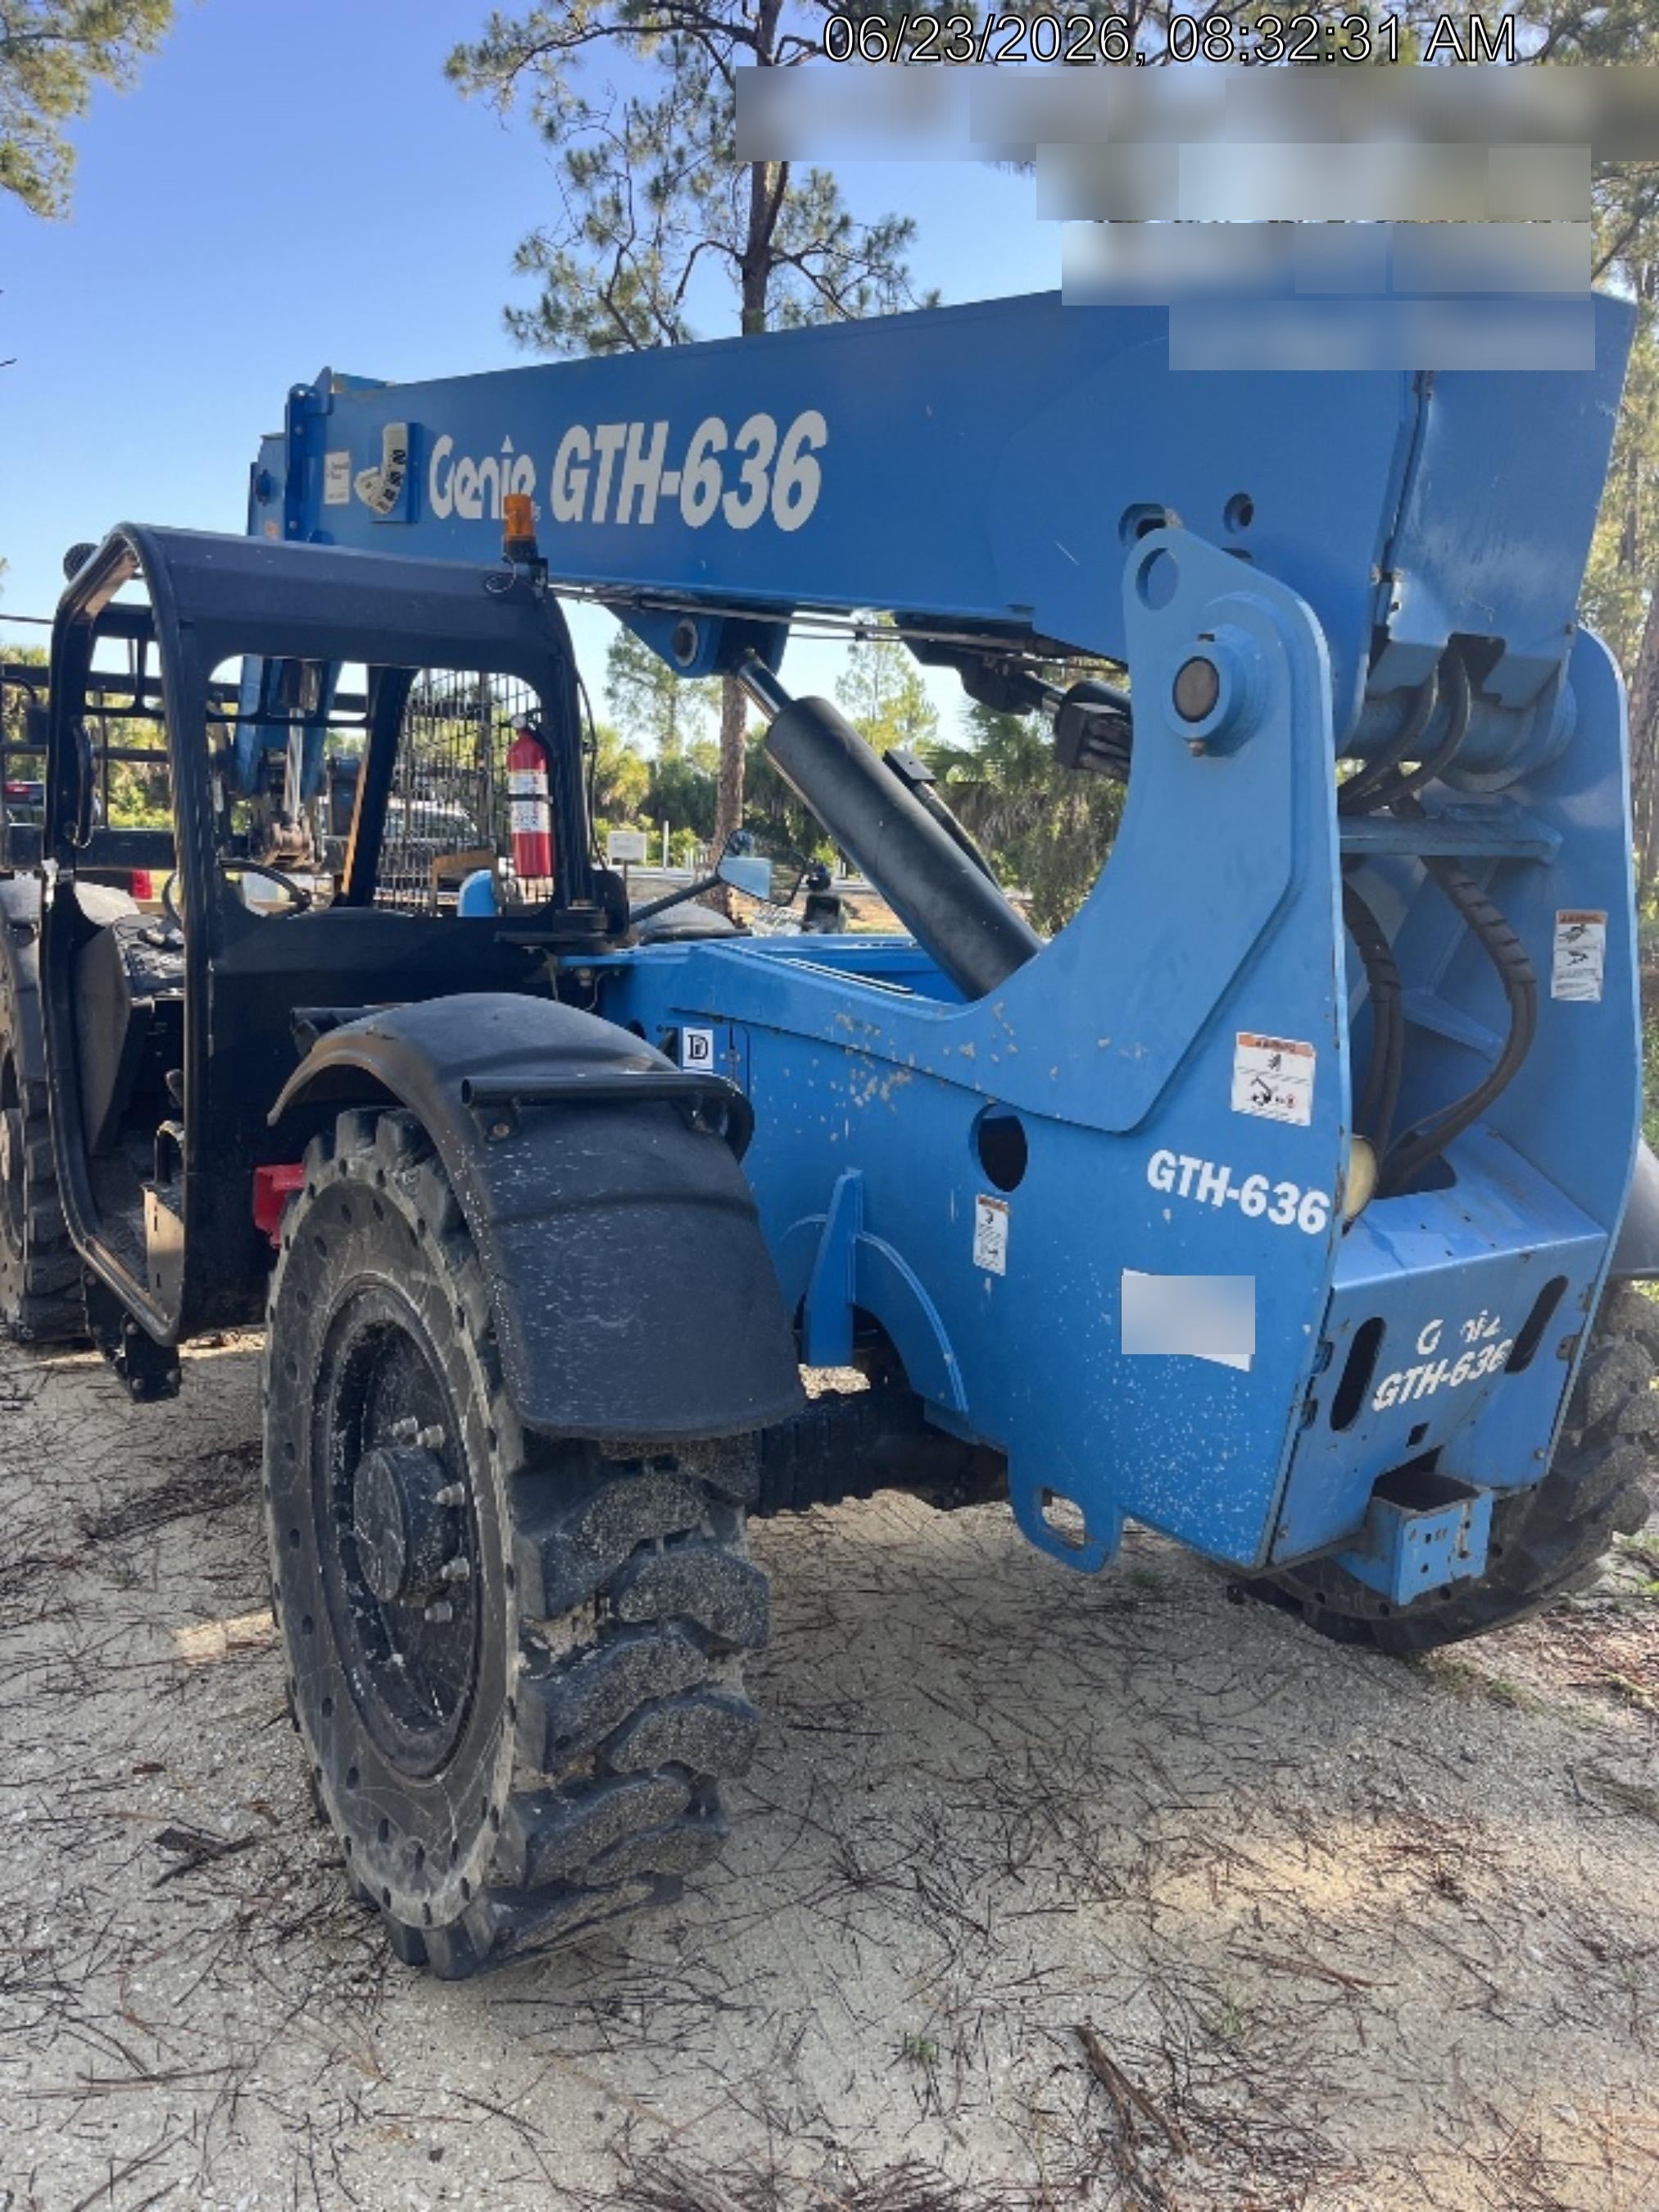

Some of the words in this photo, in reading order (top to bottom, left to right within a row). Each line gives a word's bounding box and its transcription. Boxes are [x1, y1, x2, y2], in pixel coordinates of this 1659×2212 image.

[551, 410, 827, 532] GTH-636
[1147, 1149, 1330, 1235] GTH-636
[1371, 1338, 1514, 1412] GTH-636
